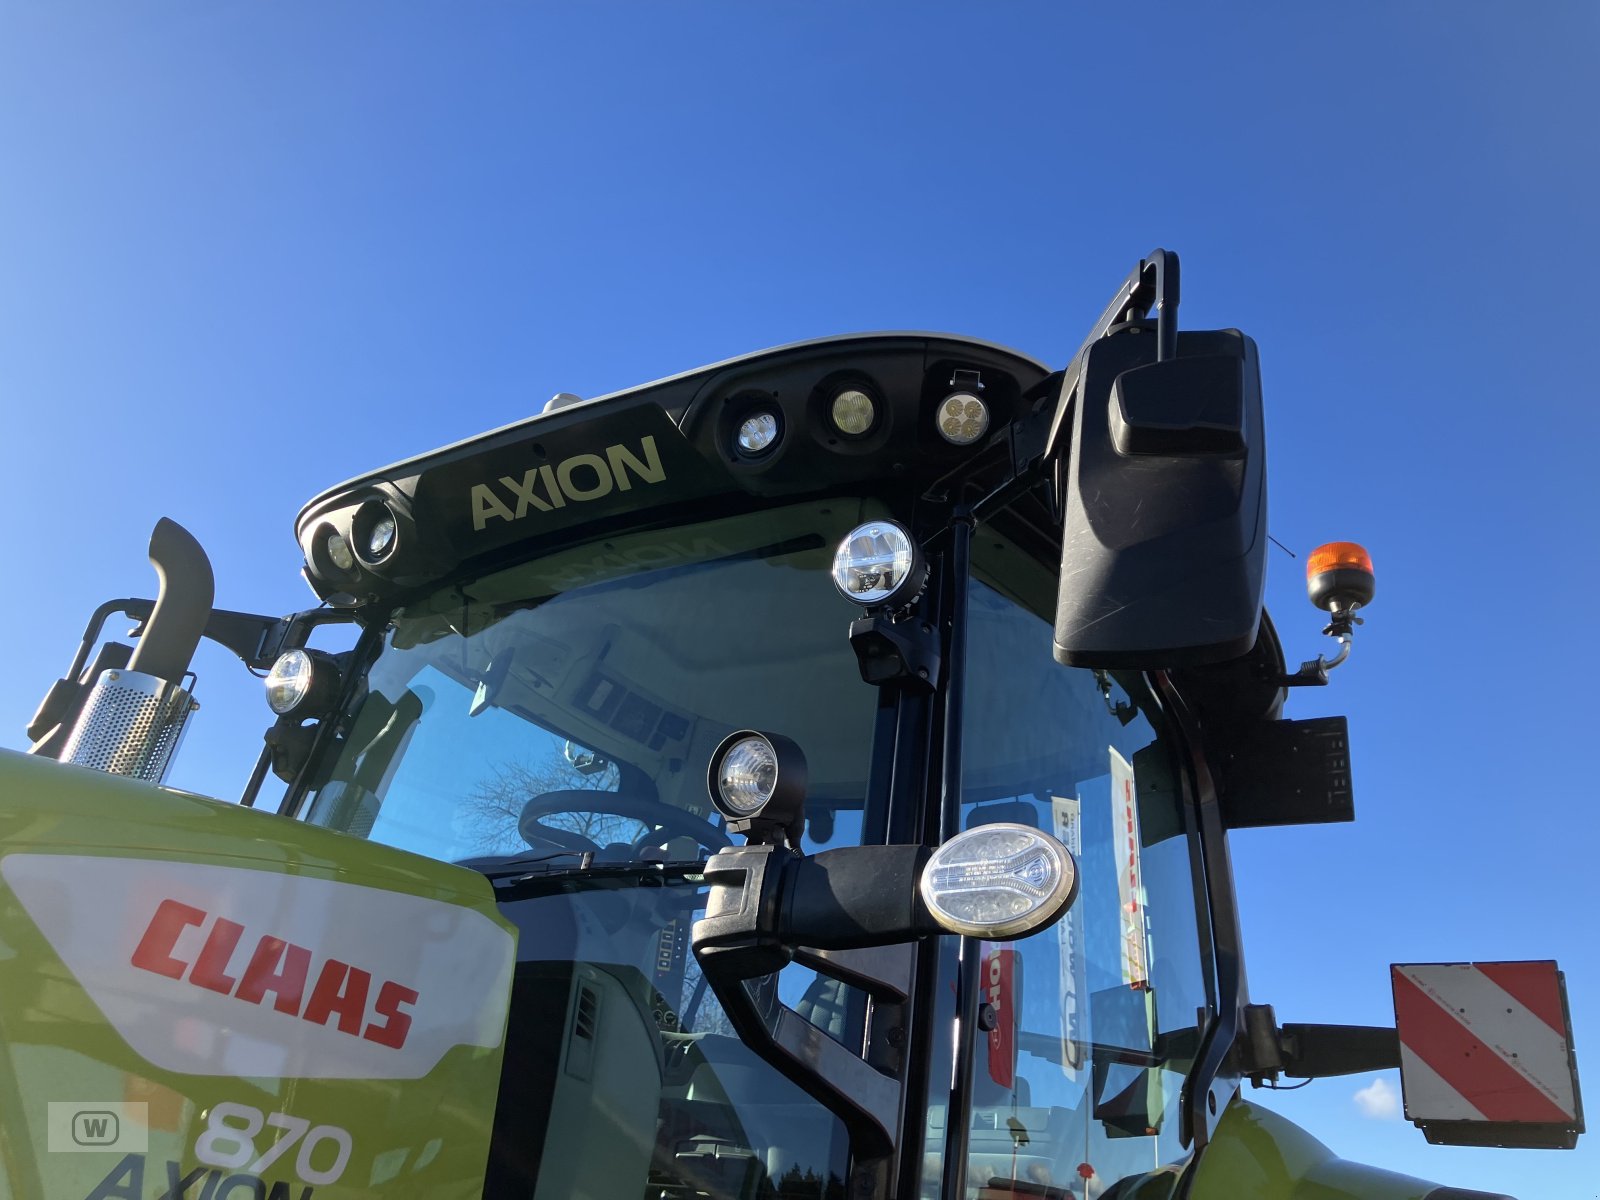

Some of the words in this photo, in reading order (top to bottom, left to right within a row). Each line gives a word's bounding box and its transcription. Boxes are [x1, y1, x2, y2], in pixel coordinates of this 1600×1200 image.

[471, 435, 667, 532] AXION
[131, 899, 419, 1050] CLAAS
[194, 1101, 353, 1185] 870
